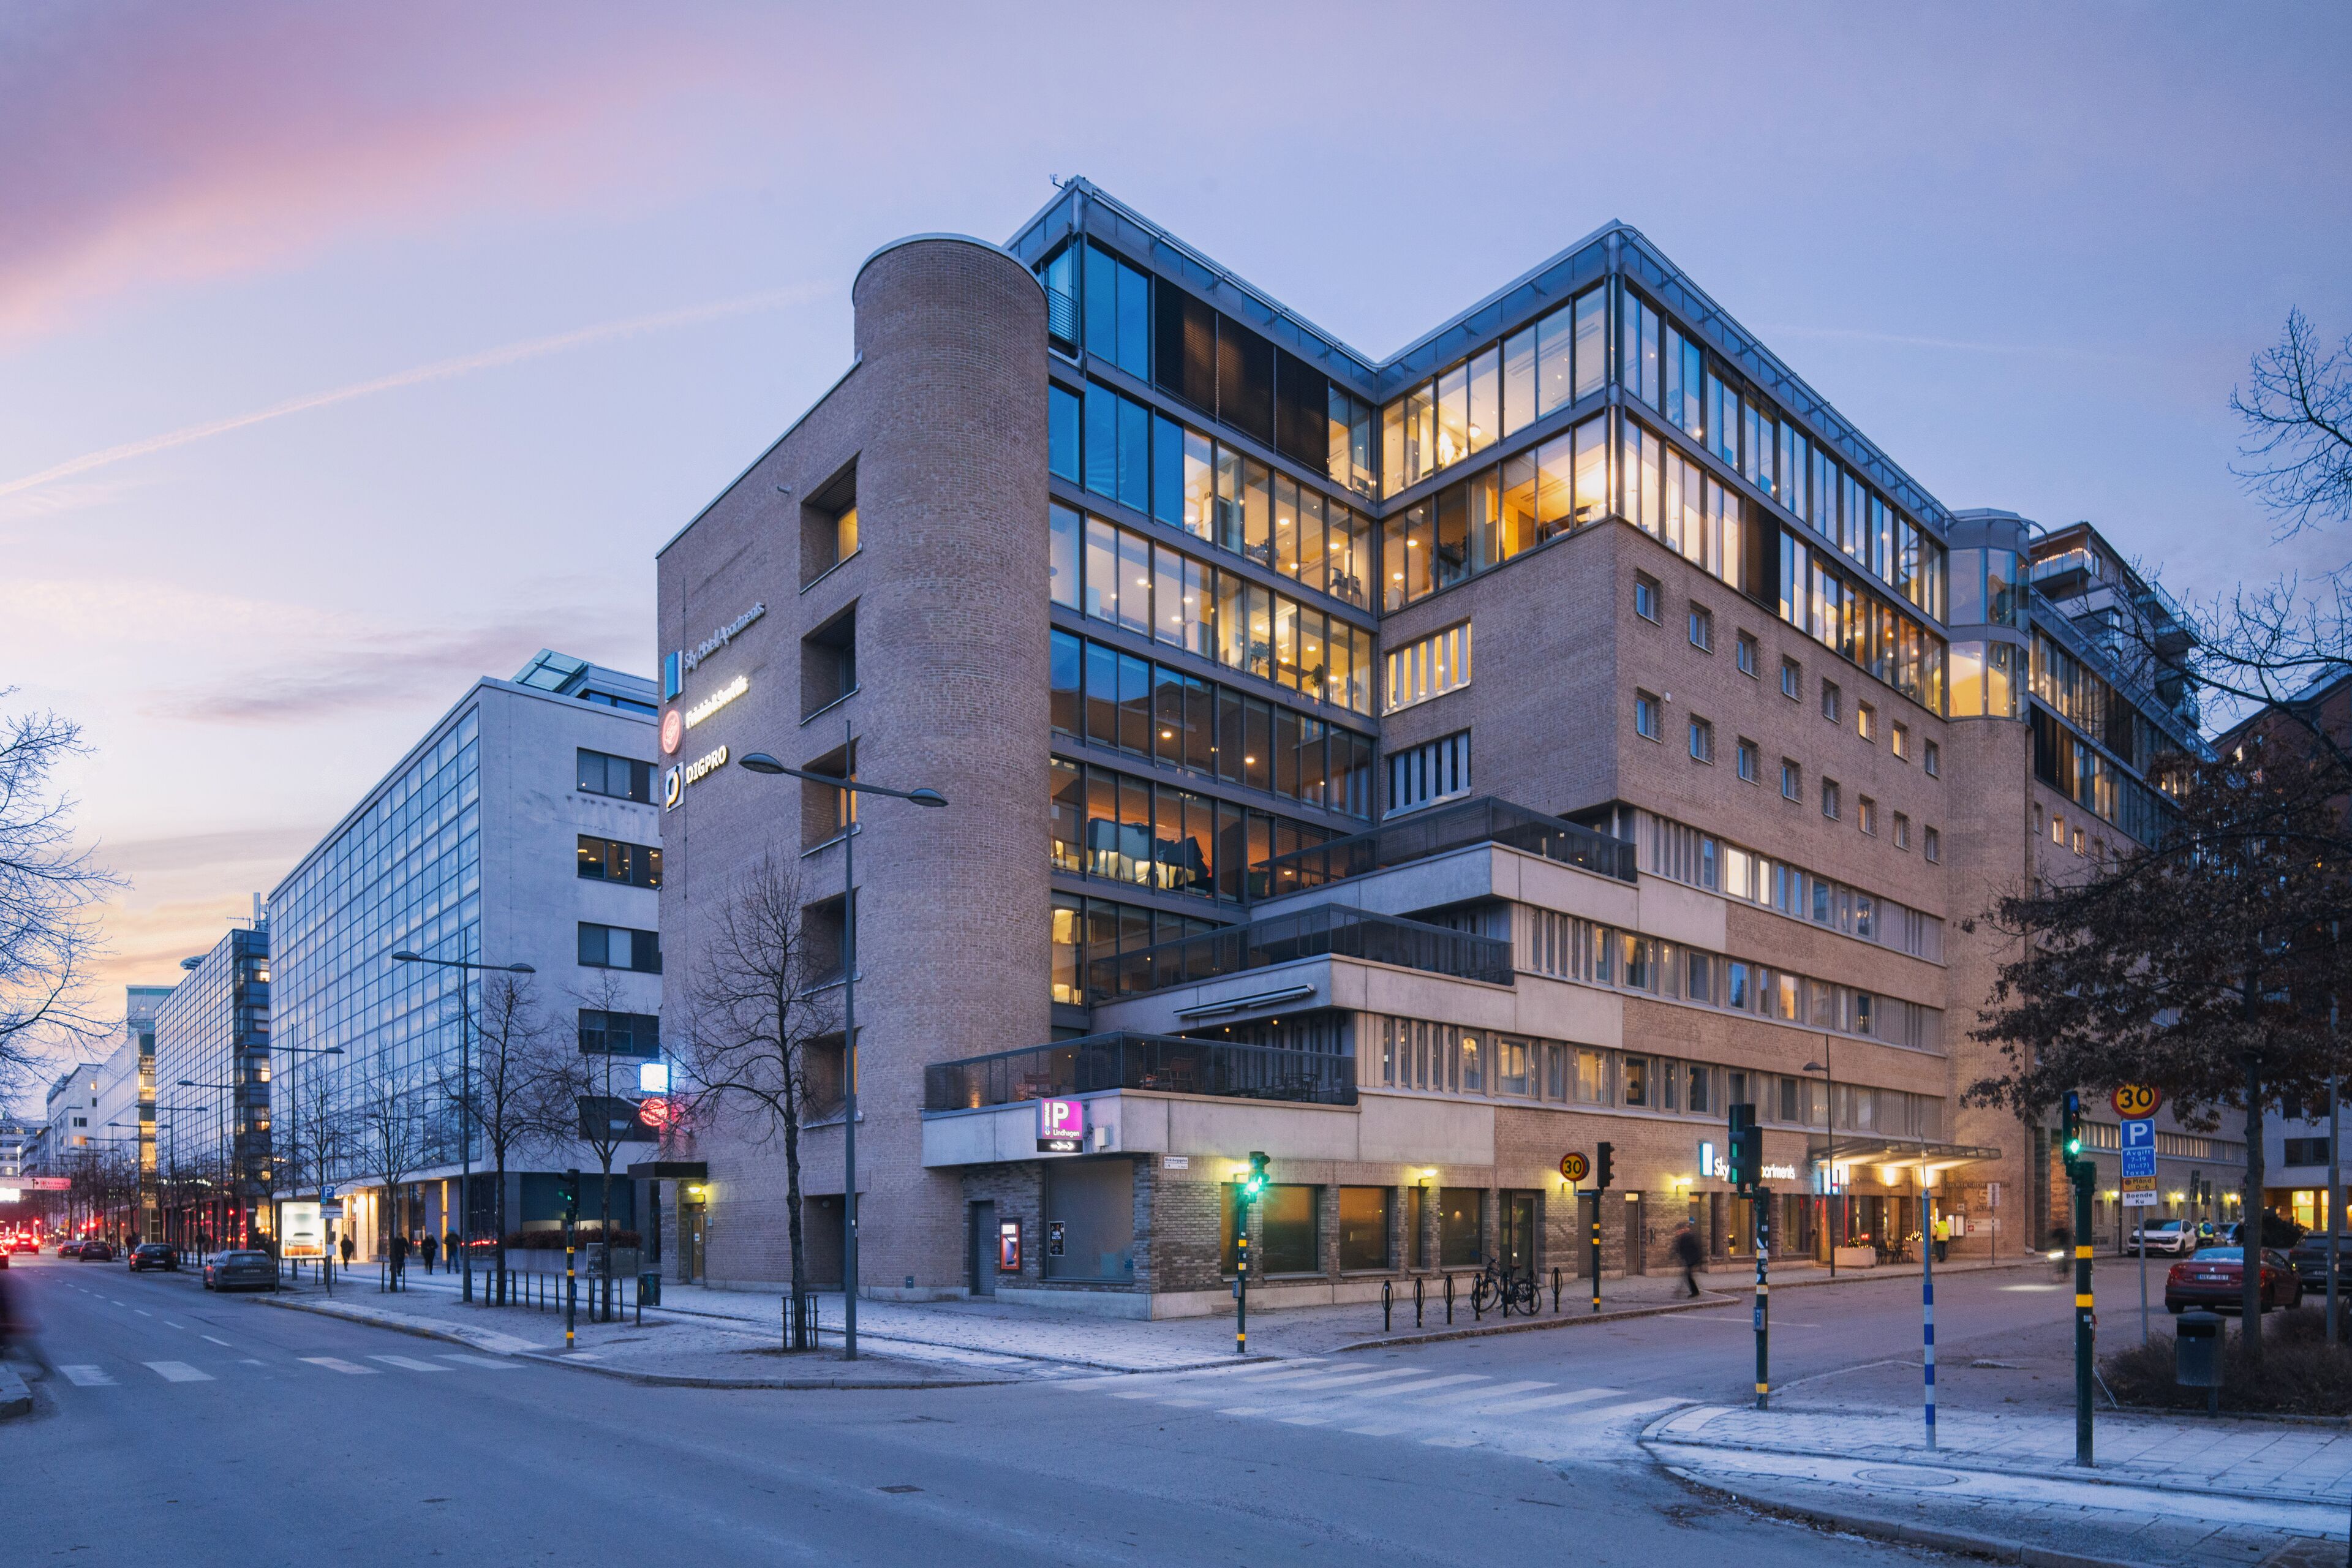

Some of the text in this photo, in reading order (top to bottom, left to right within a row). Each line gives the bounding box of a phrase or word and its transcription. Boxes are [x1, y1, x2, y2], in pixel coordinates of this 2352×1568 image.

[685, 649, 698, 671] Sky
[720, 601, 765, 645] Apartments
[686, 745, 727, 785] DIGPRO
[2119, 1087, 2153, 1109] 30
[1053, 1102, 1069, 1128] P
[1053, 1129, 1080, 1138] Lindhagen
[2130, 1123, 2148, 1145] P
[1564, 1159, 1582, 1174] 30
[1714, 1156, 1795, 1181] Sky artments
[325, 1188, 333, 1197] P
